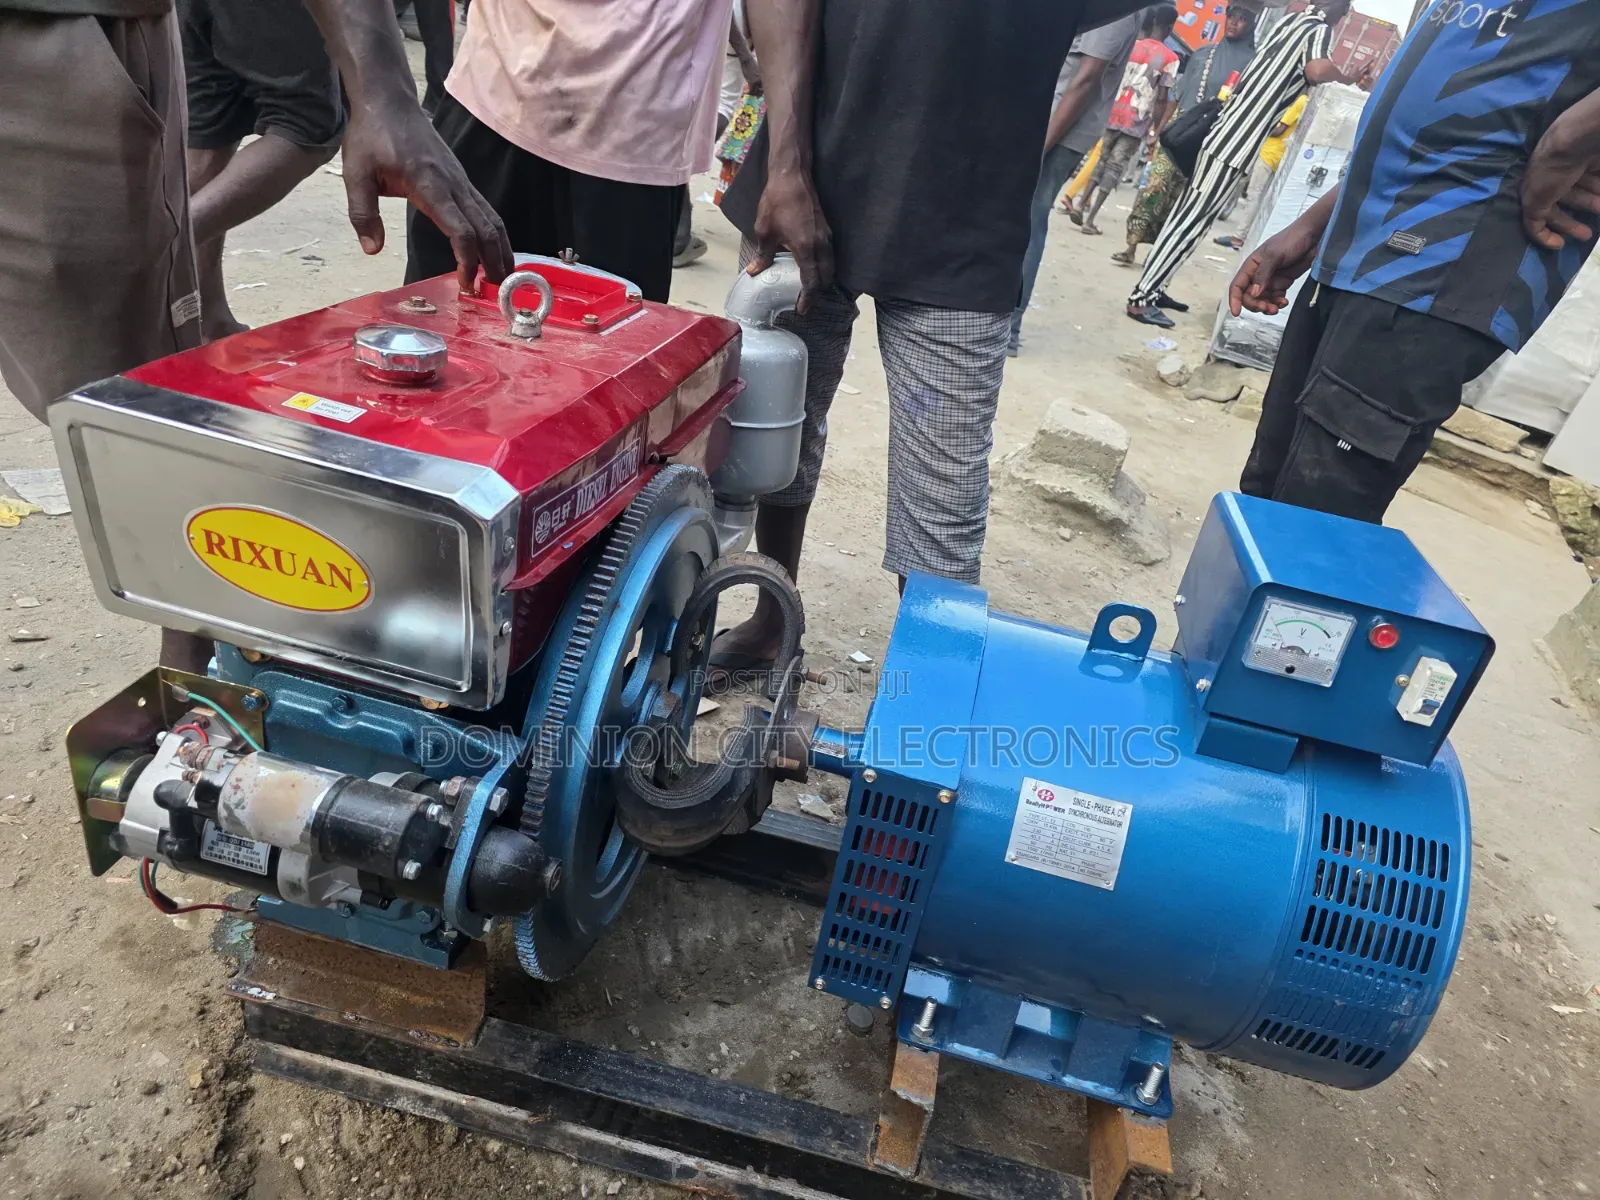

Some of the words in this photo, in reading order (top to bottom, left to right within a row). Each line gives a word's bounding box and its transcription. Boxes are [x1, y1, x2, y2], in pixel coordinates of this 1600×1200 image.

[574, 470, 609, 520] DIESEL
[609, 445, 639, 493] ENGINE
[200, 528, 353, 593] RIXUAN
